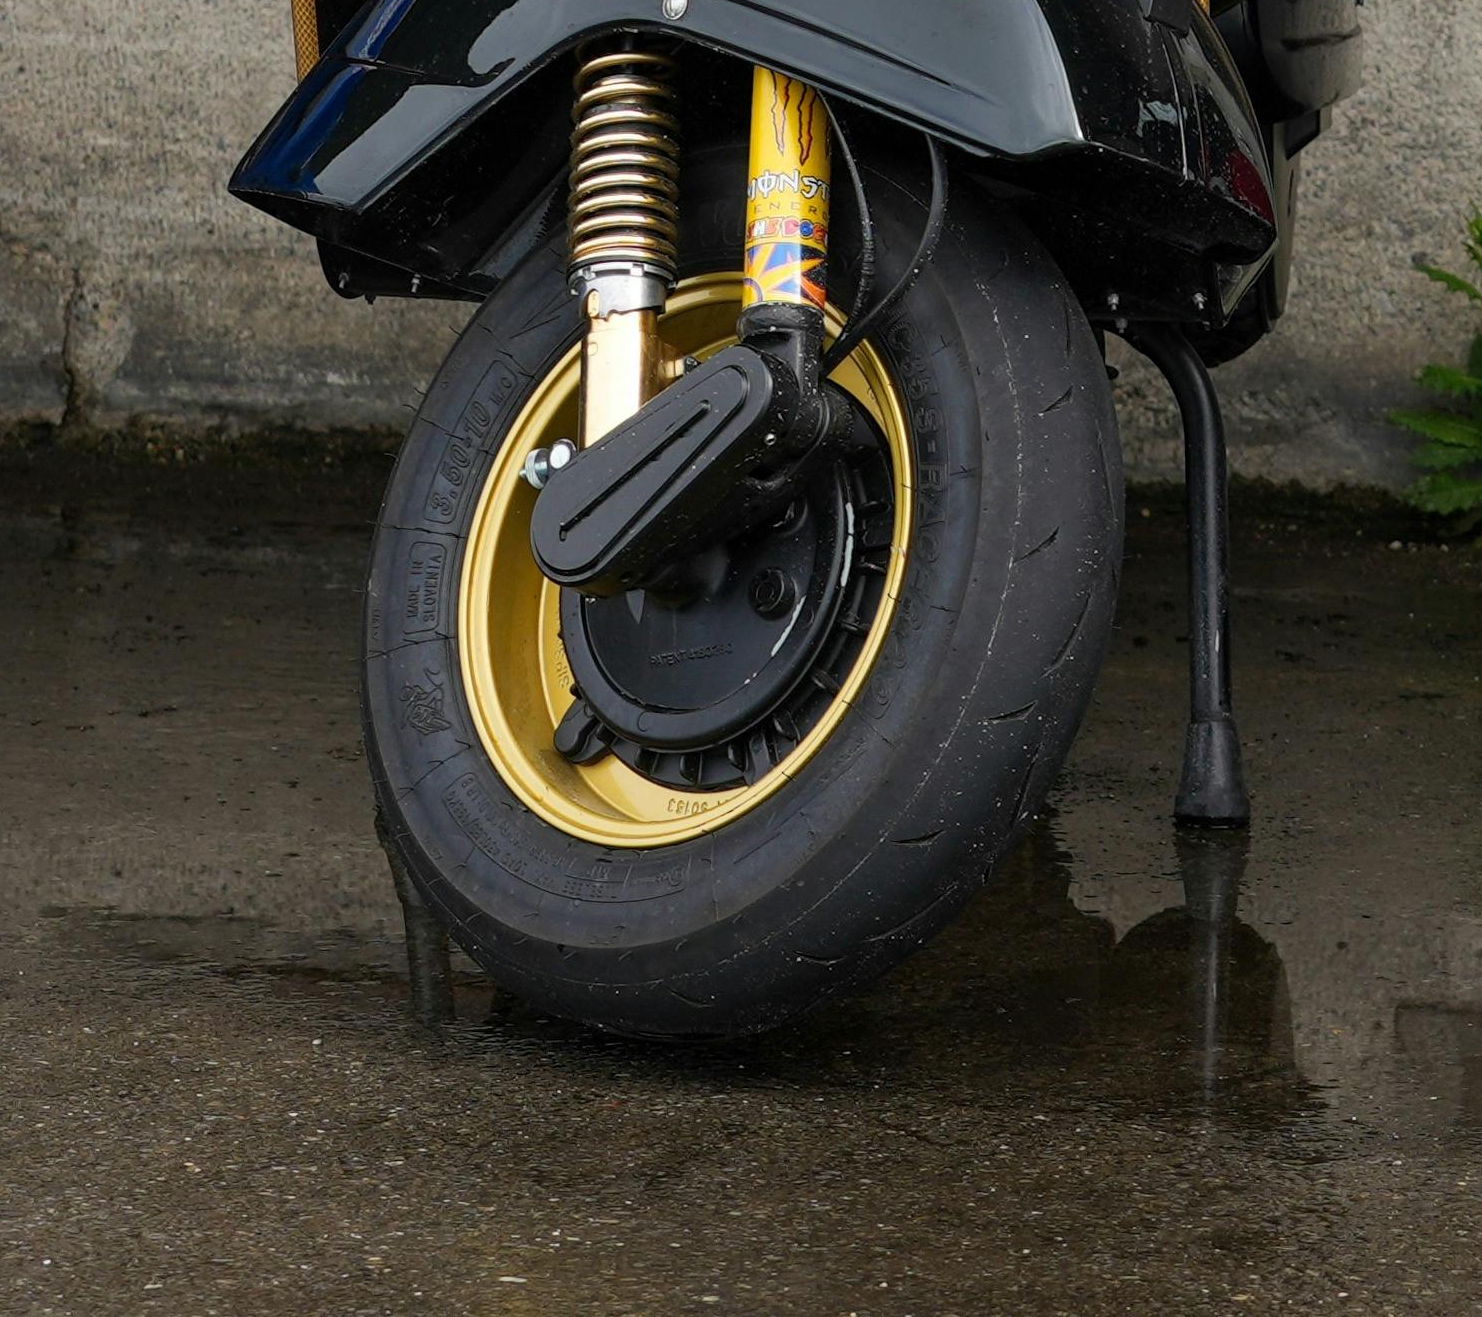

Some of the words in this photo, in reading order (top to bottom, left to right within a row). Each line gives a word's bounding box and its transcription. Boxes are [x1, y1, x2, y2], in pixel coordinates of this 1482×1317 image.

[430, 401, 491, 516] 3.50-10
[406, 588, 422, 619] MADE
[422, 554, 443, 623] SLOVENIA
